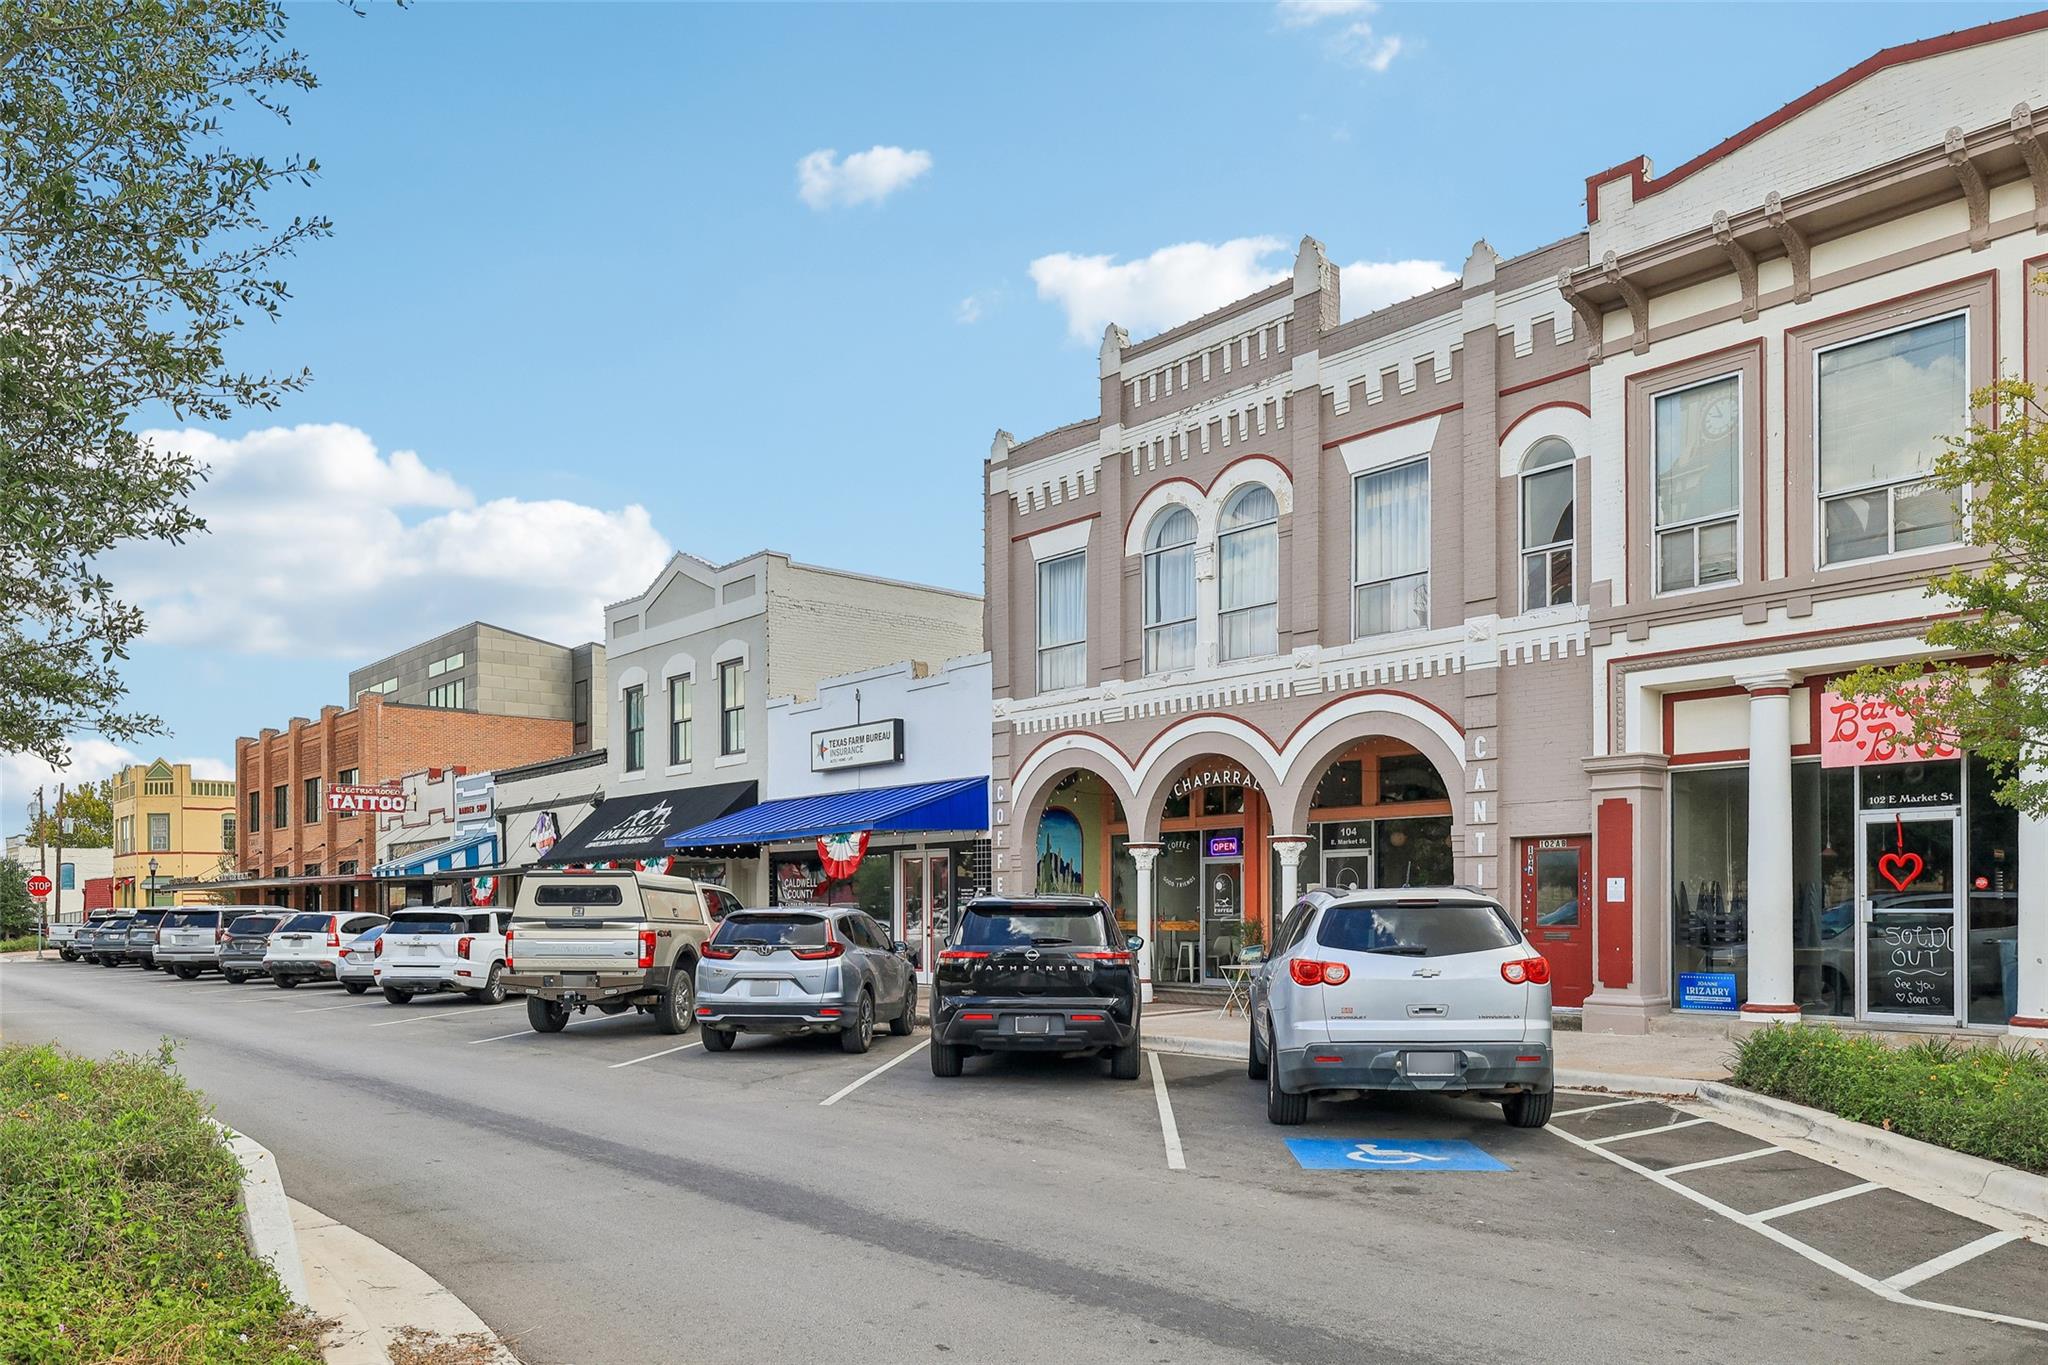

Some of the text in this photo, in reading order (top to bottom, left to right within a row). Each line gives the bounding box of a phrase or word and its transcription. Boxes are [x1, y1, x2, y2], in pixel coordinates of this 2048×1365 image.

[828, 730, 891, 748] TEXAS FARM BUREAU
[830, 745, 864, 757] INSURANCE
[1174, 770, 1261, 796] CHAPARRAL
[335, 786, 373, 794] ELECTRIC
[329, 794, 405, 811] TATTOO
[1869, 792, 1954, 804] 102 E Market St
[1340, 827, 1357, 836] 104
[996, 785, 1004, 892] COFFEE
[1167, 841, 1191, 850] COFFEE
[1213, 842, 1236, 852] OPEN
[28, 881, 51, 891] STOP
[784, 878, 818, 888] CALDWELL
[787, 889, 814, 899] COUNTY
[1885, 926, 1946, 948] SOLD
[1891, 947, 1940, 967] OUT
[974, 964, 1092, 972] PATHFINDER
[1894, 977, 1912, 990] See
[1686, 986, 1730, 996] IRIZARRY
[1907, 992, 1930, 1004] Soon
